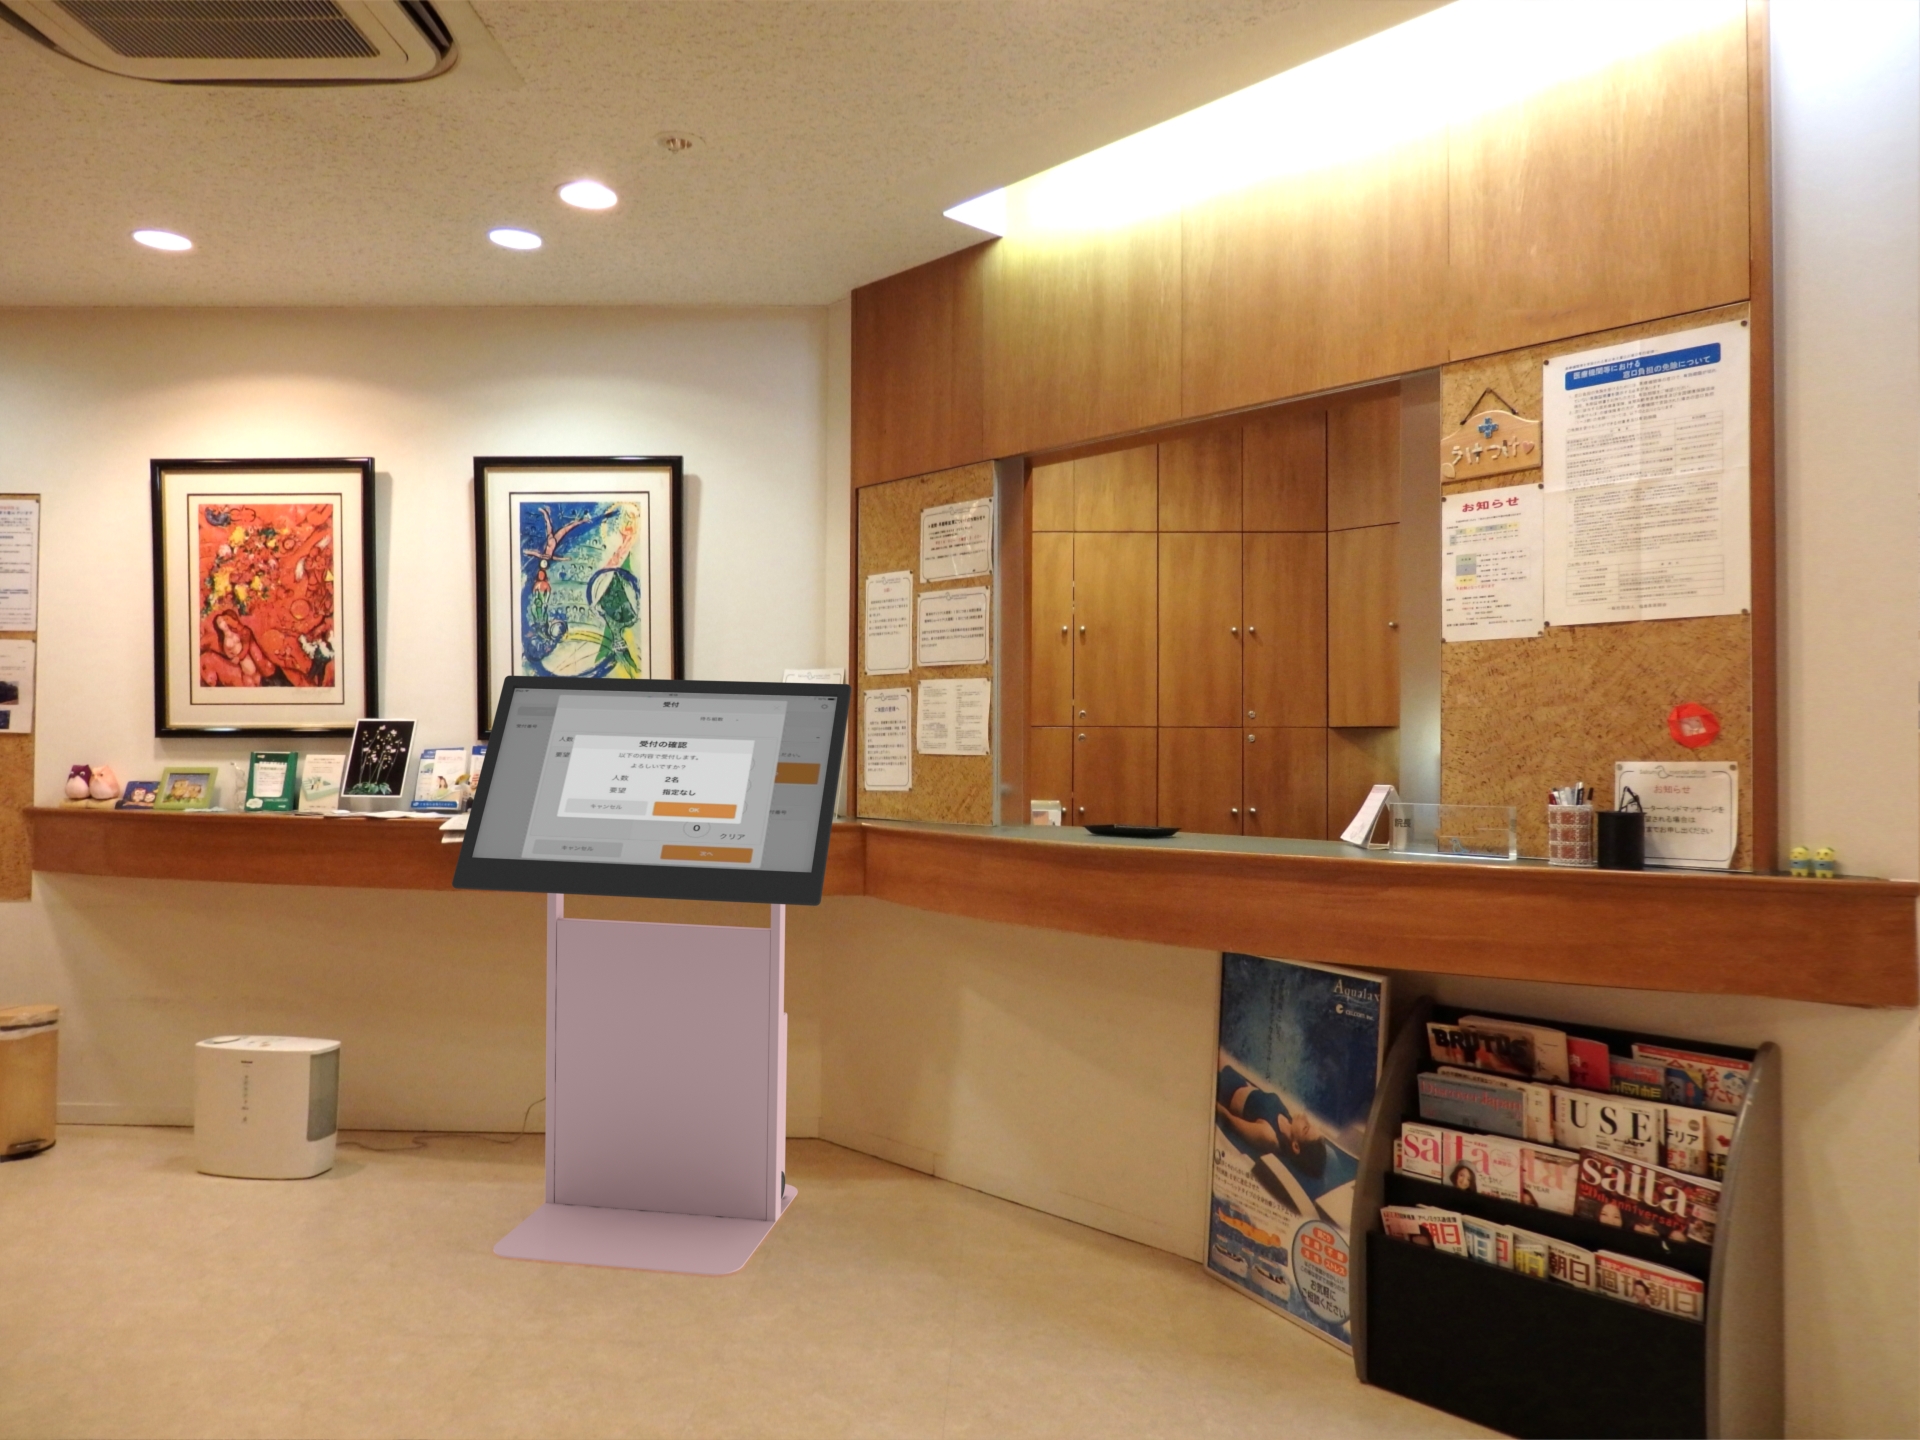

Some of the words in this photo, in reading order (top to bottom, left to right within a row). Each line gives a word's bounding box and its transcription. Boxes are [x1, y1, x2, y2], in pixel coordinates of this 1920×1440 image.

[1573, 359, 1641, 381] 医療機関等における
[1623, 355, 1711, 379] 窓口負担の免除について
[1451, 436, 1520, 465] うけつけ
[1462, 496, 1520, 513] お知らせ
[662, 701, 680, 709] 受付
[638, 740, 688, 749] 受付の確認
[618, 752, 699, 761] 以下の内容で受付します。
[630, 763, 686, 771] よろしいですか？
[611, 774, 630, 782] 人数
[664, 776, 680, 784] 2名
[608, 786, 627, 794] 要望
[662, 788, 697, 796] 指定なし
[1653, 785, 1691, 794] お知らせ
[692, 824, 701, 832] 0
[1394, 818, 1412, 828] 院長
[1431, 1028, 1530, 1060] BRUTUS
[1533, 1185, 1550, 1194] YEAR
[1581, 1158, 1689, 1218] saita
[1325, 1260, 1346, 1276] ストレス
[1549, 1251, 1591, 1286] 朝日
[1310, 1280, 1337, 1301] お気軽に
[1301, 1287, 1348, 1319] ご相談ください
